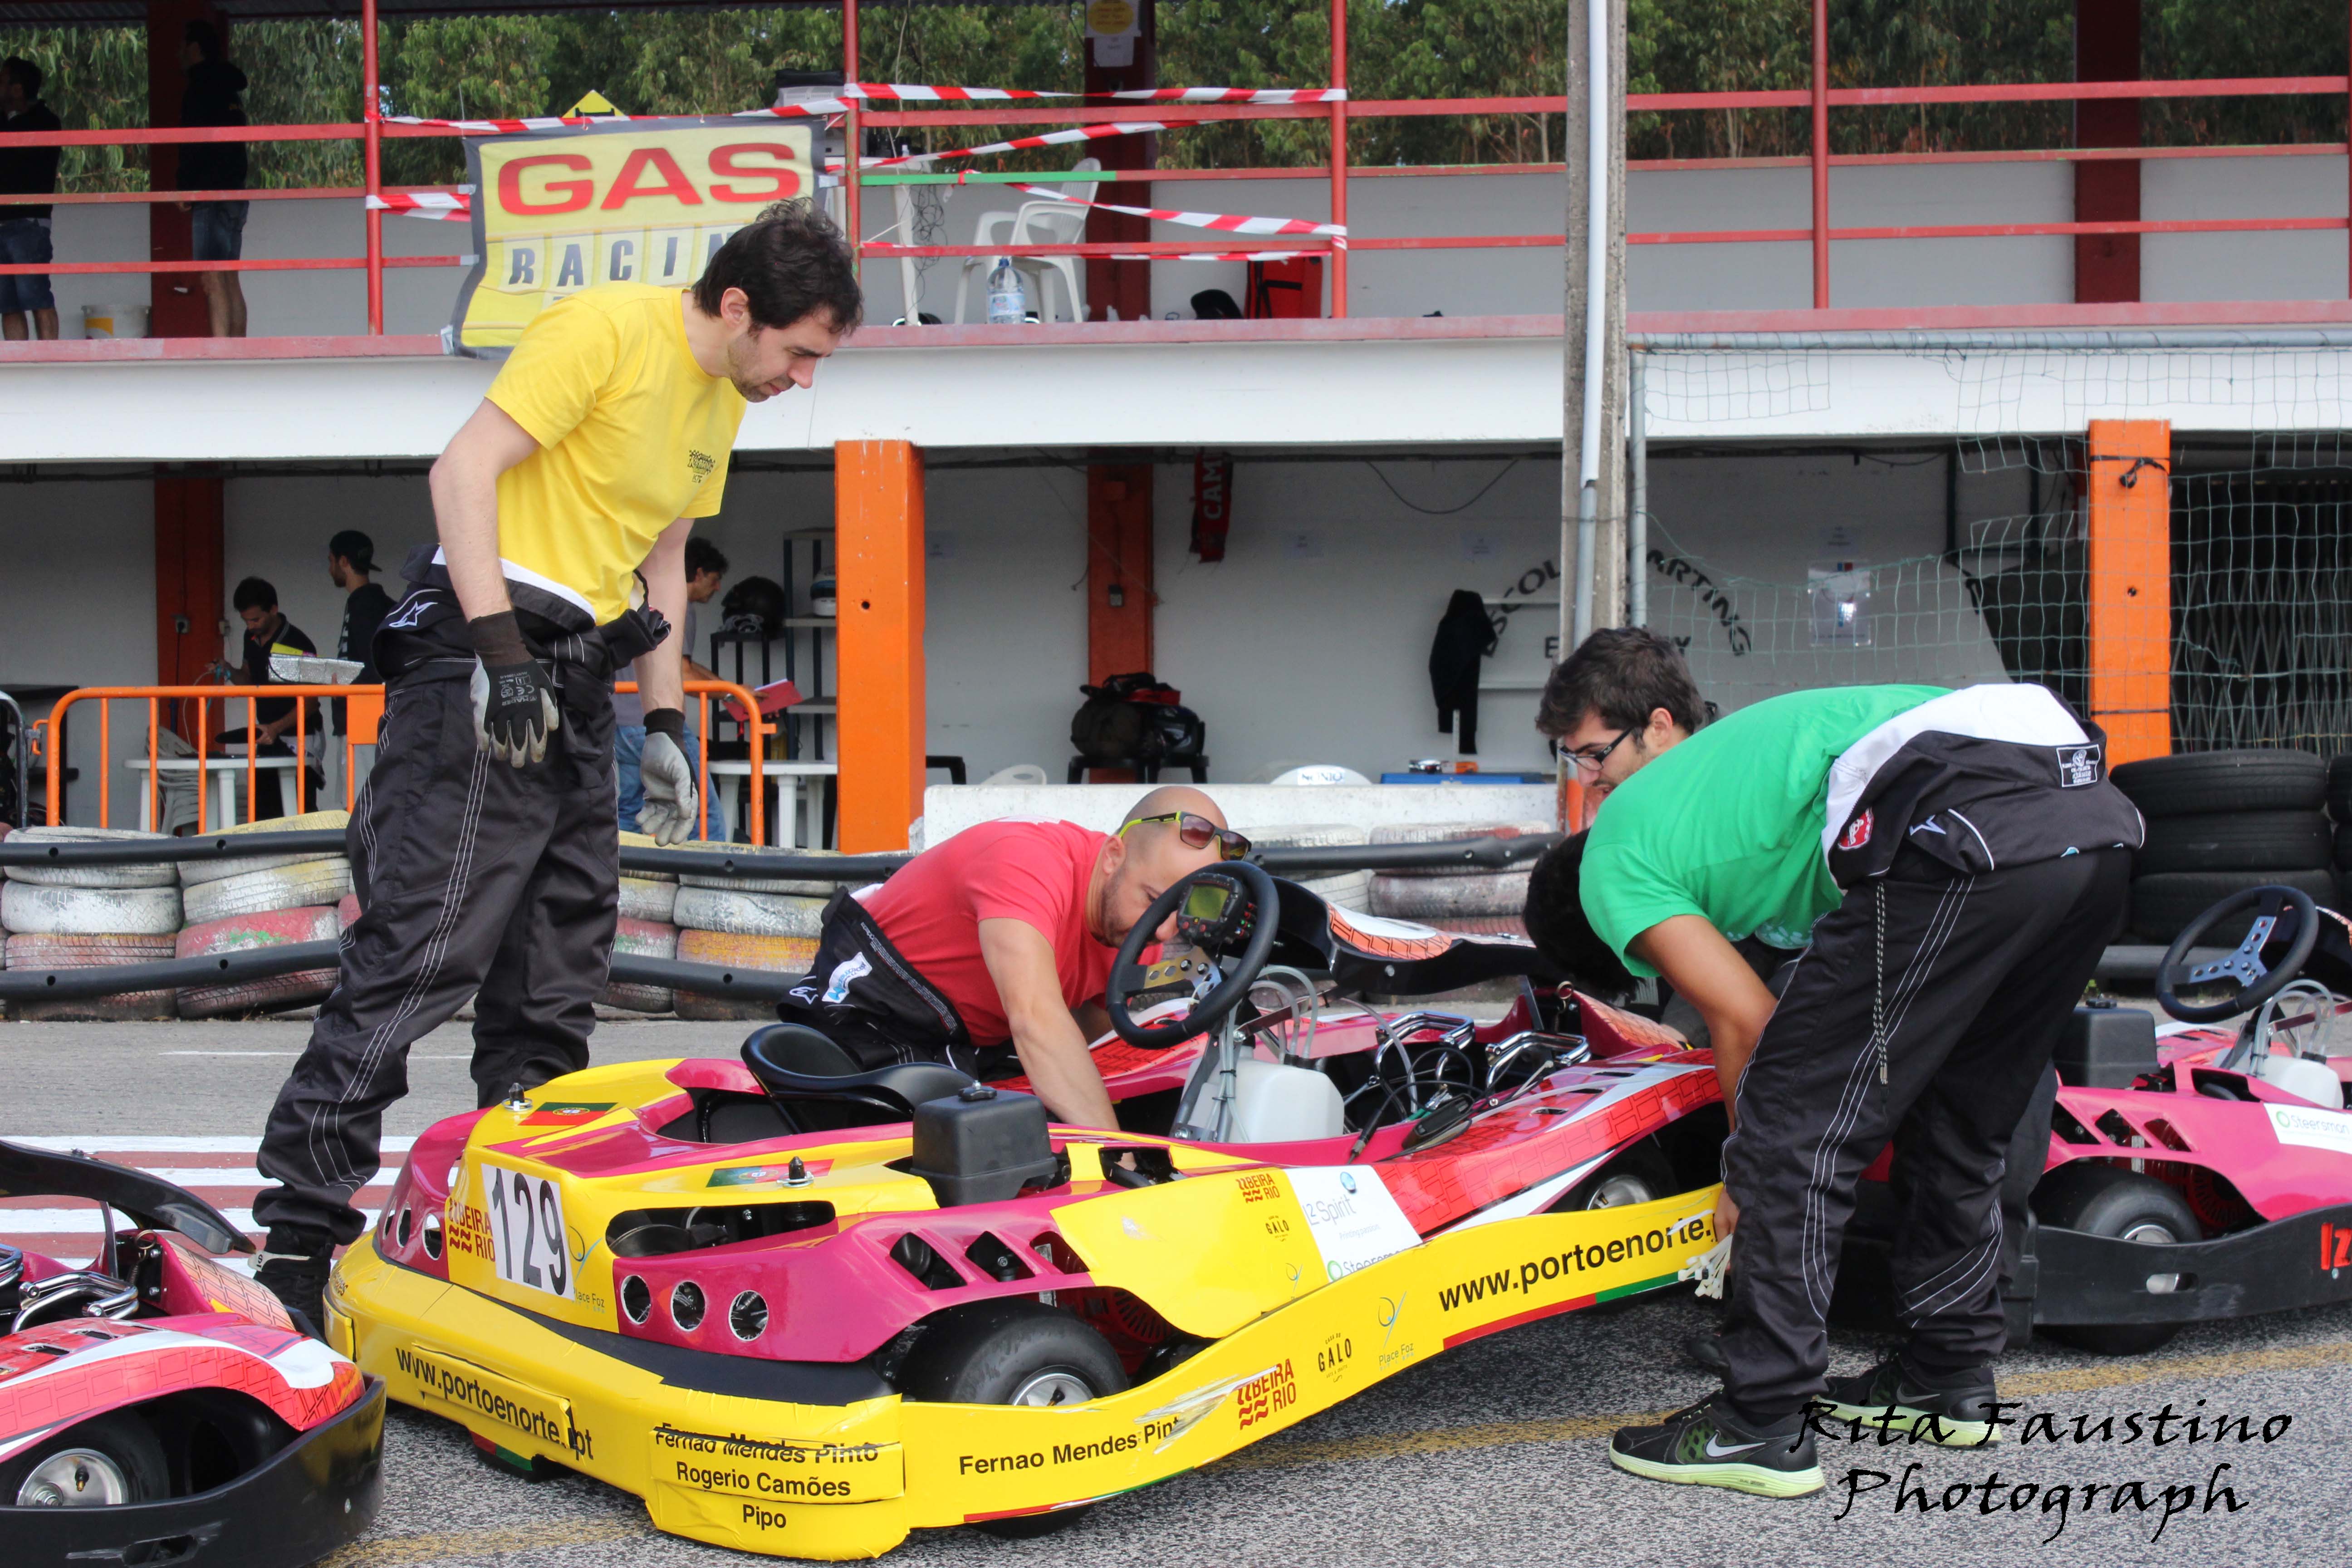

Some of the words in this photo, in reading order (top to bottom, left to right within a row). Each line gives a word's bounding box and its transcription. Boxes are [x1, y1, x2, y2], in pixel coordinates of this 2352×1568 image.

[498, 143, 800, 216] GAS
[1263, 1186, 1280, 1200] RIO
[492, 1168, 566, 1296] 129
[1266, 1220, 1289, 1234] GALO
[475, 1234, 496, 1262] RIO
[1439, 1213, 1717, 1311] www.portoenorte.
[592, 1293, 605, 1308] Foz
[1318, 1338, 1352, 1372] GALO
[1379, 1350, 1399, 1366] Place
[1401, 1343, 1414, 1355] Foz
[1273, 1382, 1296, 1412] RIO
[815, 1442, 879, 1463] Pinto
[959, 1452, 1044, 1475] Fernao
[1053, 1435, 1137, 1465] Mendes
[676, 1460, 750, 1489] Rogerio
[756, 1472, 851, 1496] Camões
[743, 1504, 787, 1530] Pipo
